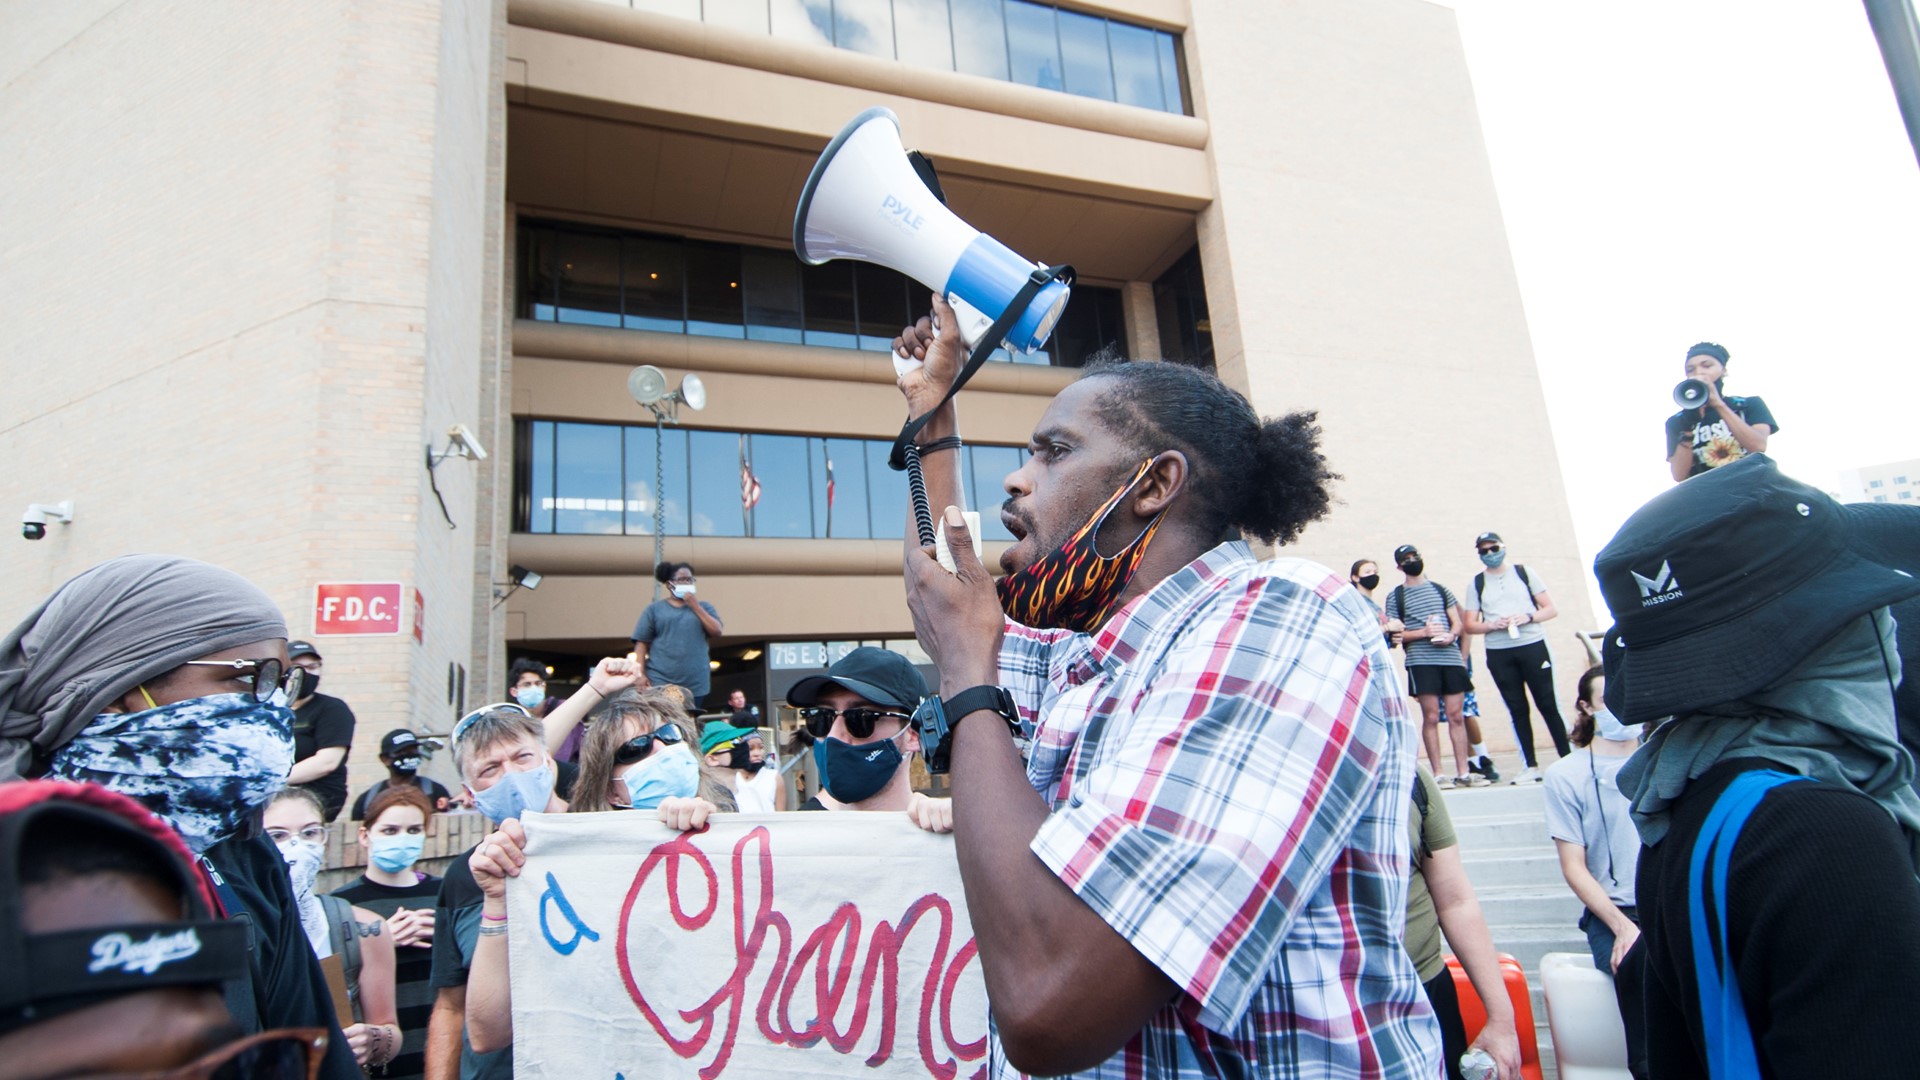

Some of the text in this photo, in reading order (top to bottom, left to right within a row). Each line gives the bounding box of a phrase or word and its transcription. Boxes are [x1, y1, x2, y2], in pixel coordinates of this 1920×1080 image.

[323, 596, 392, 622] F.D.C.
[1641, 590, 1683, 608] MISSION
[775, 646, 797, 665] 715
[801, 646, 814, 664] E.
[88, 927, 202, 974] Dodgers
